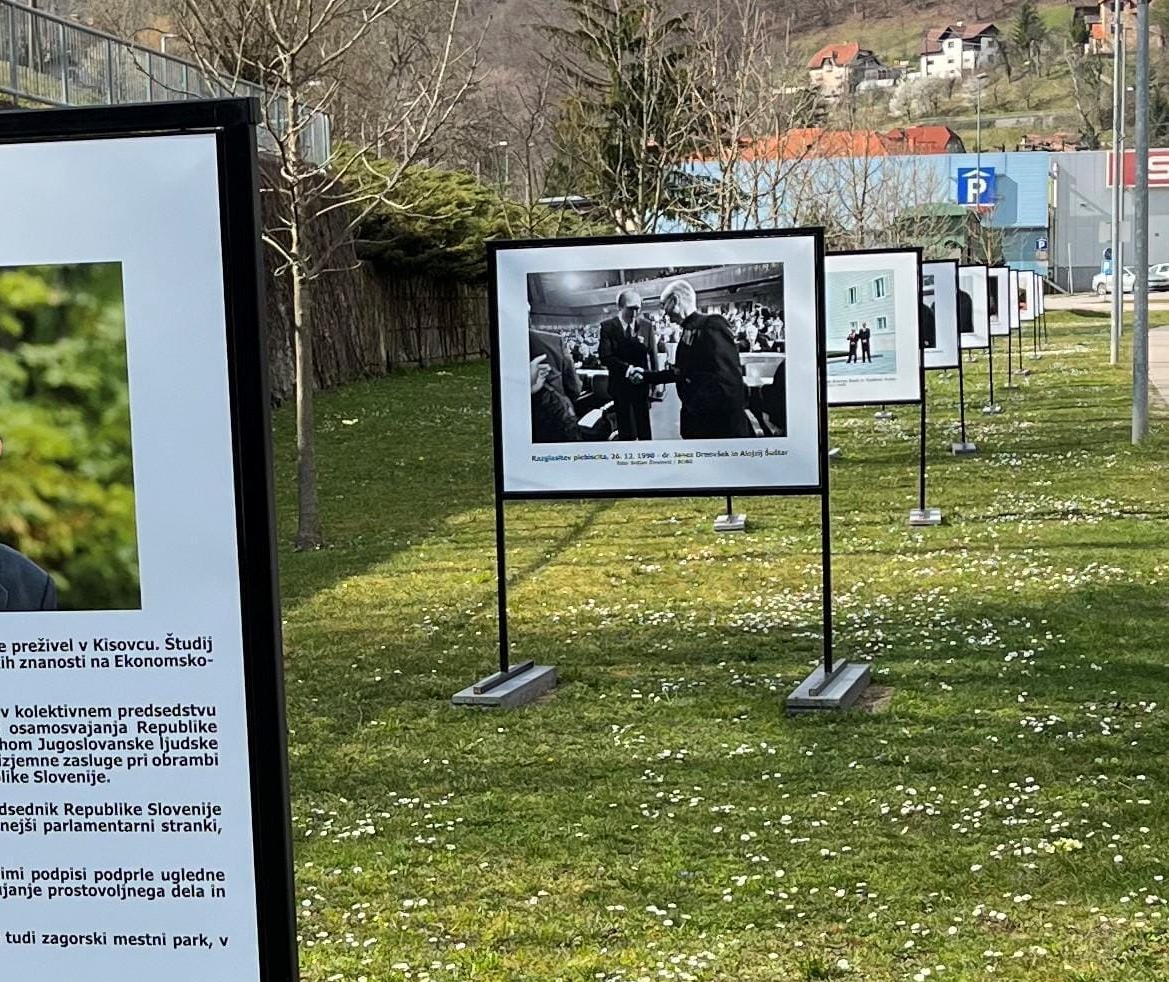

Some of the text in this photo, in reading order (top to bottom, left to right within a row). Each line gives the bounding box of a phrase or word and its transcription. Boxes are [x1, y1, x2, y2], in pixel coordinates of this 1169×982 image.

[967, 178, 987, 203] P
[11, 638, 73, 655] preživel
[77, 641, 88, 651] v
[93, 637, 160, 651] Kisovcu.
[164, 633, 212, 653] Študij
[18, 654, 86, 668] znanosti
[90, 657, 110, 668] na
[114, 653, 213, 667] Ekonomsko-
[9, 720, 130, 737] osamosvajanja
[136, 720, 218, 736] Republike
[37, 737, 155, 753] Jugoslovanske
[159, 736, 218, 753] ljudske
[31, 770, 110, 786] Slovenije.
[63, 803, 142, 818] Republike
[147, 803, 221, 818] Slovenije
